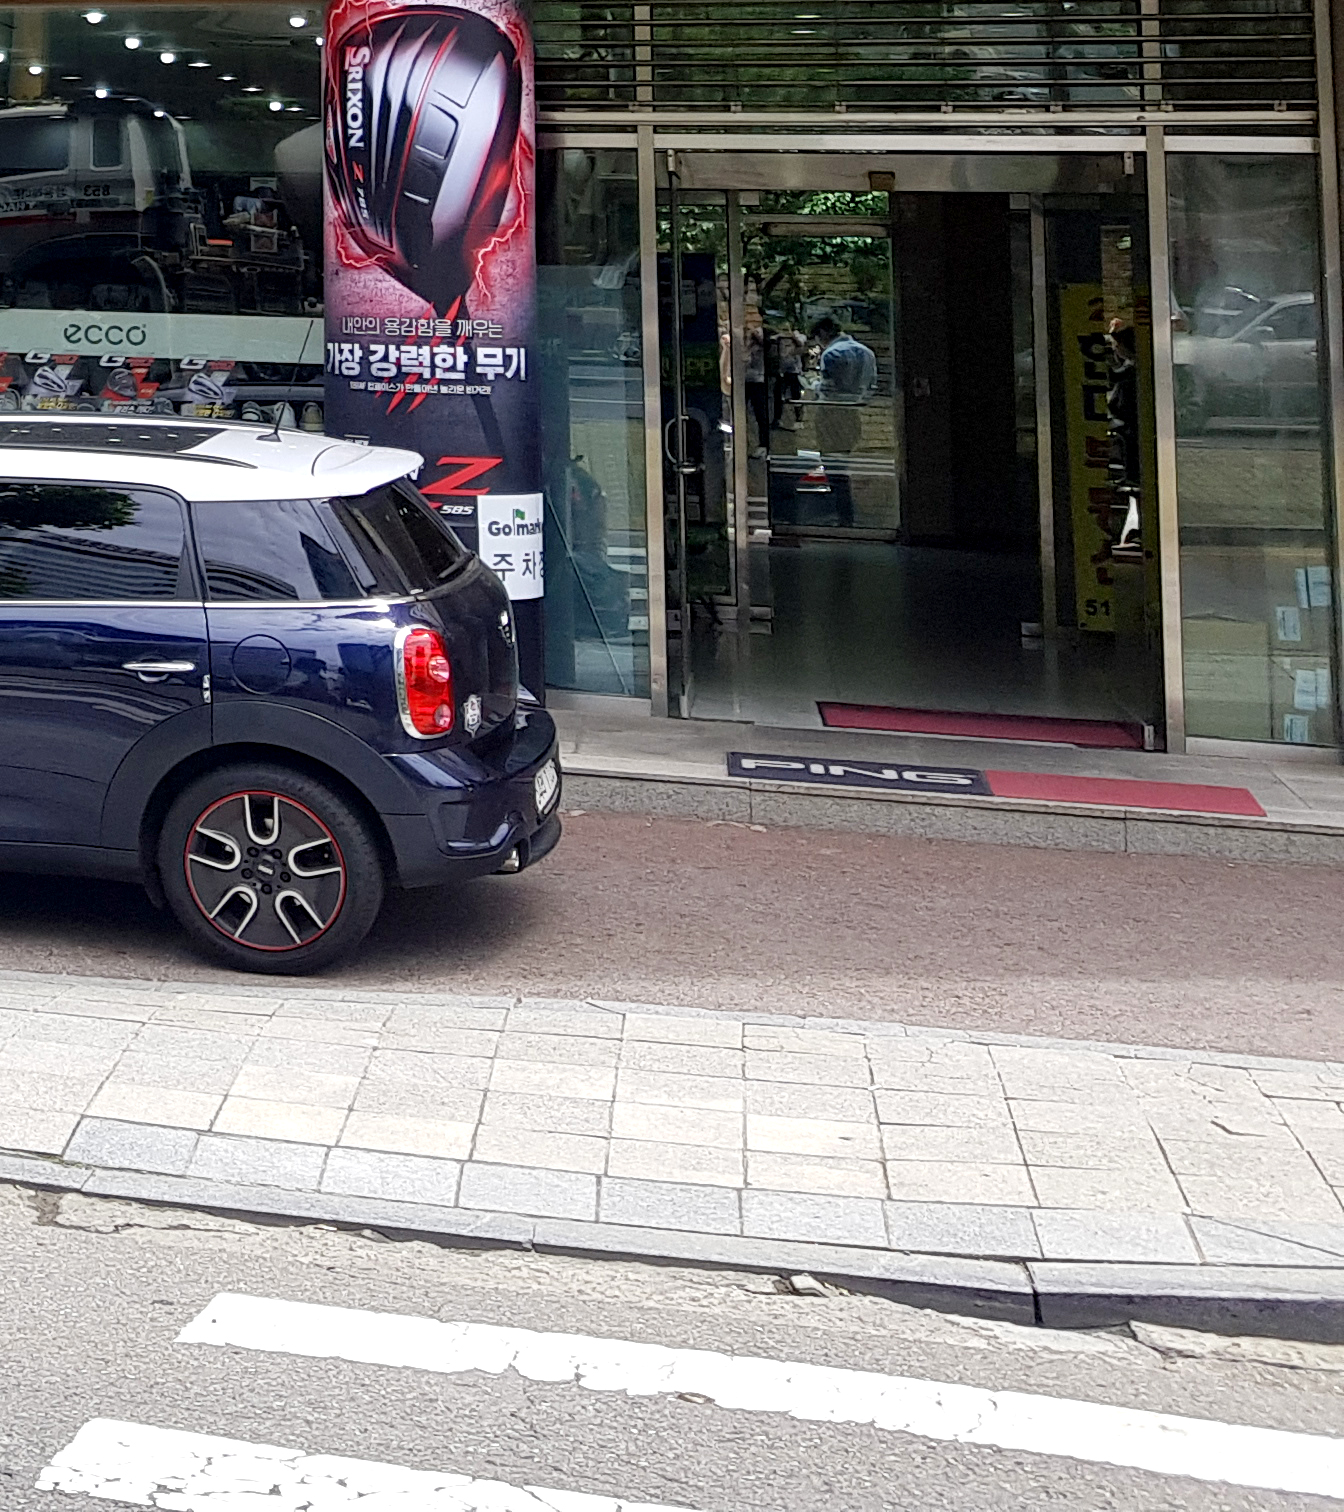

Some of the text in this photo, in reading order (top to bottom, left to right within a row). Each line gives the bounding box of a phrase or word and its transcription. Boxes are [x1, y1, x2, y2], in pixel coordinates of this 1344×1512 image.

[345, 46, 371, 149] SRIXON
[63, 322, 144, 348] ecco
[342, 316, 503, 338] 내안의 용감함을 깨우는
[327, 342, 526, 381] 가장 강력한 무기
[419, 456, 503, 496] Z
[741, 758, 977, 786] PING
